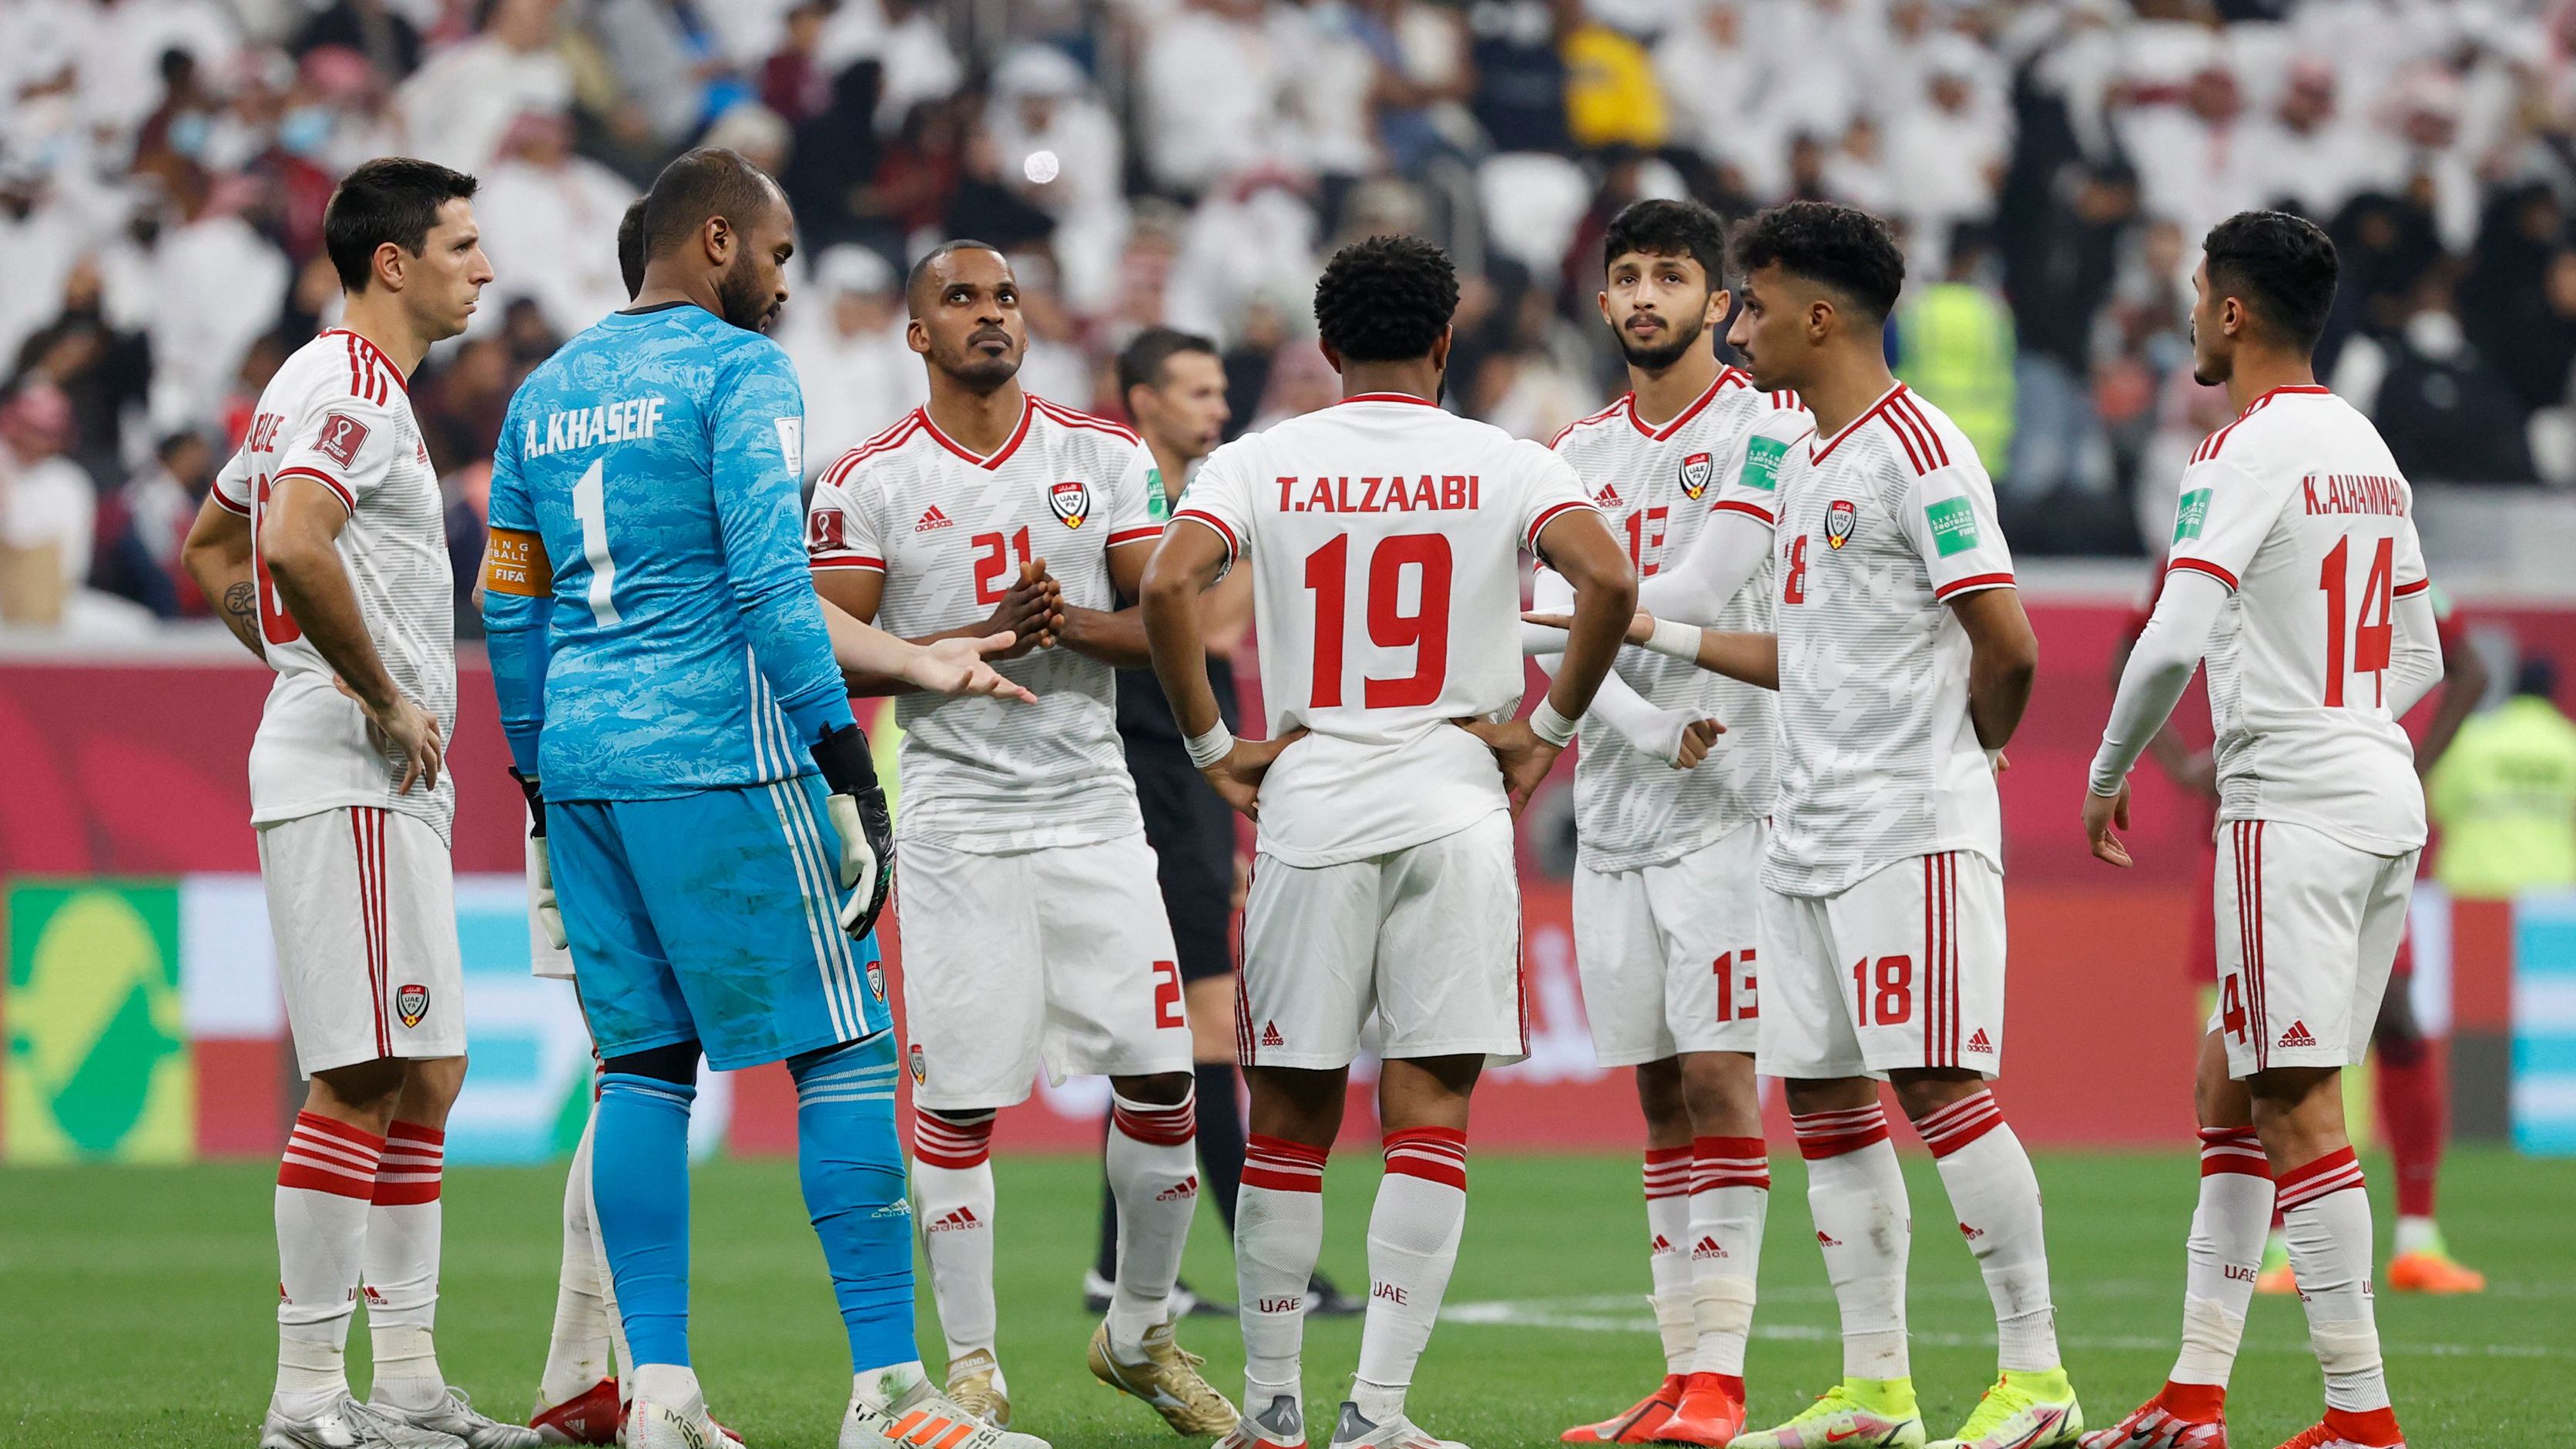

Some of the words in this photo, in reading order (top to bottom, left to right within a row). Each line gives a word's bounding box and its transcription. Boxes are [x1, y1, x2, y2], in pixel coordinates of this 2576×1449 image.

[524, 397, 666, 461] A.KHASEIF
[1689, 465, 1705, 475] UAE
[1059, 494, 1079, 502] UAE
[1276, 475, 1479, 512] T.ALZAABI
[1834, 514, 1849, 522] UAE
[1932, 510, 1971, 525] LIVING
[1934, 516, 1973, 532] FOOTBALL
[914, 519, 954, 532] adidas
[1958, 527, 1975, 537] FIFA
[572, 457, 623, 628] 1
[971, 525, 1031, 605] 21
[495, 569, 526, 582] FIFA
[1305, 532, 1453, 709] 19
[2319, 534, 2393, 708] 14
[1853, 954, 1912, 1028] 18
[1263, 1037, 1284, 1046] adidas
[1967, 1043, 1993, 1054] adidas
[2278, 1037, 2316, 1048] adidas
[927, 1221, 984, 1233] adidas
[1692, 1250, 1729, 1262] adidas
[2224, 1264, 2257, 1283] UAE
[1373, 1281, 1409, 1306] UAE
[1259, 1296, 1301, 1313] UAE
